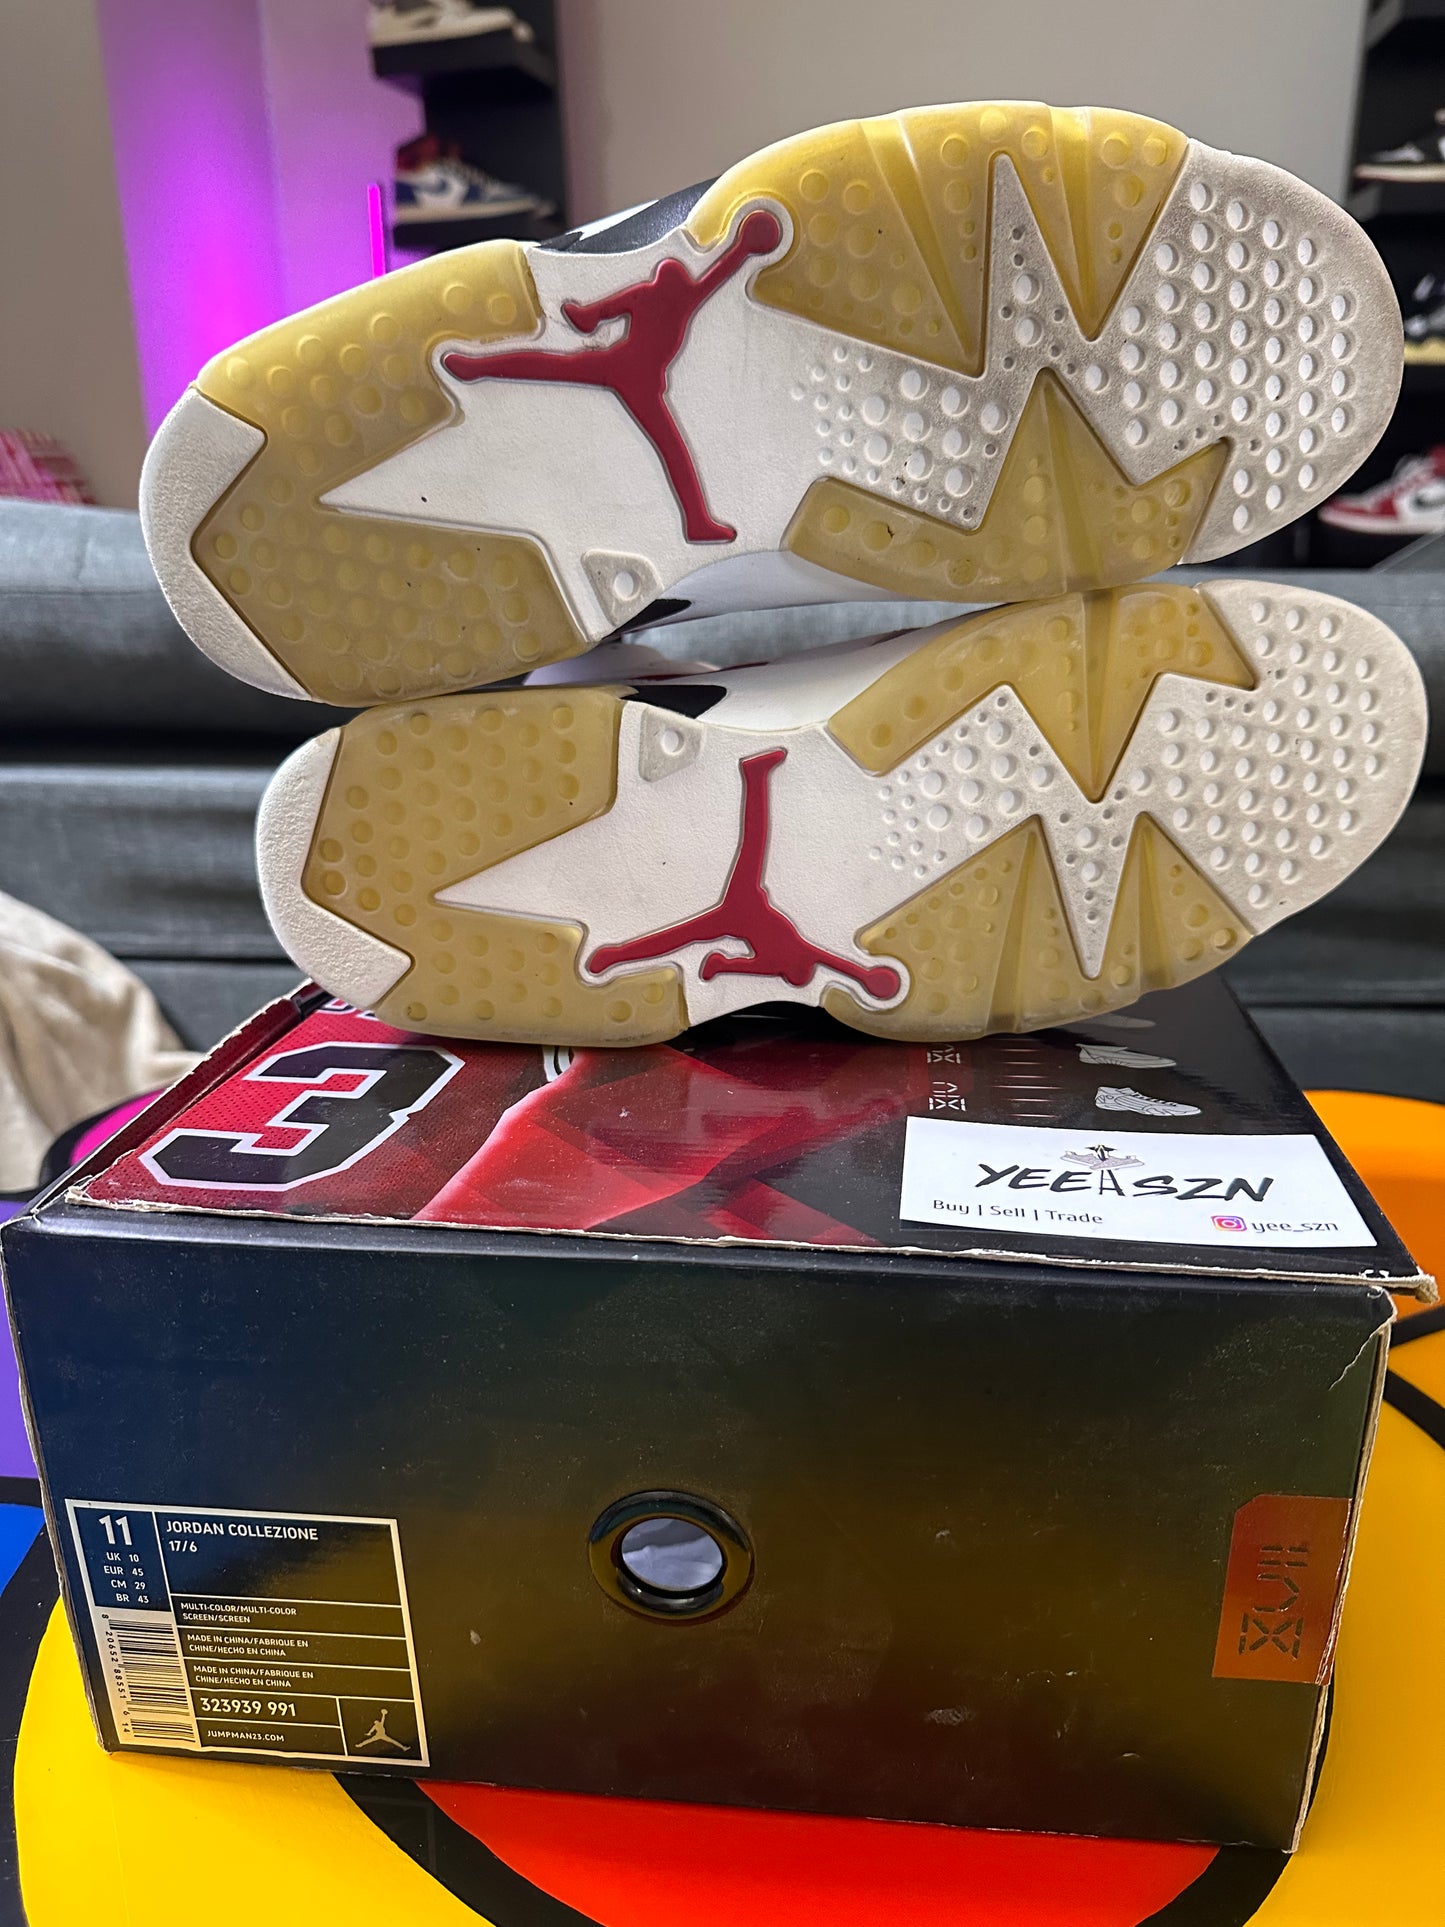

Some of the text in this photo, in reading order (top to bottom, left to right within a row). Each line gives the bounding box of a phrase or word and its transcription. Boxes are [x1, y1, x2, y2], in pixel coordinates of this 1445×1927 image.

[137, 1041, 465, 1192] 3
[932, 1199, 970, 1215] Buy
[989, 1204, 1025, 1218] Sell
[1044, 1209, 1104, 1224] Trade
[1250, 1219, 1340, 1234] yee_szn
[98, 1514, 133, 1546] 11
[166, 1520, 319, 1541] JORDAN COLLEZIONE
[168, 1540, 198, 1553] 17/6
[106, 1551, 140, 1563] UK 10
[103, 1565, 144, 1577] EUR 45
[110, 1579, 146, 1590] CM 29
[115, 1593, 149, 1604] BR 43
[180, 1602, 297, 1616] MULTI-COLOR/MULTI-COLOR
[182, 1612, 251, 1623] SCREEN/SCREEN
[186, 1633, 309, 1648] MADE IN CHINA/FABRIQUE EN
[189, 1644, 287, 1657] CHINE/HECHO EN CHINA
[193, 1665, 314, 1679] MADE IN CHINA/FABRIQUE EN
[195, 1675, 292, 1688] CHINE/HECHO EN CHINA
[199, 1697, 296, 1717] 323939 991
[207, 1730, 285, 1742] JUMPMAN23.COM
